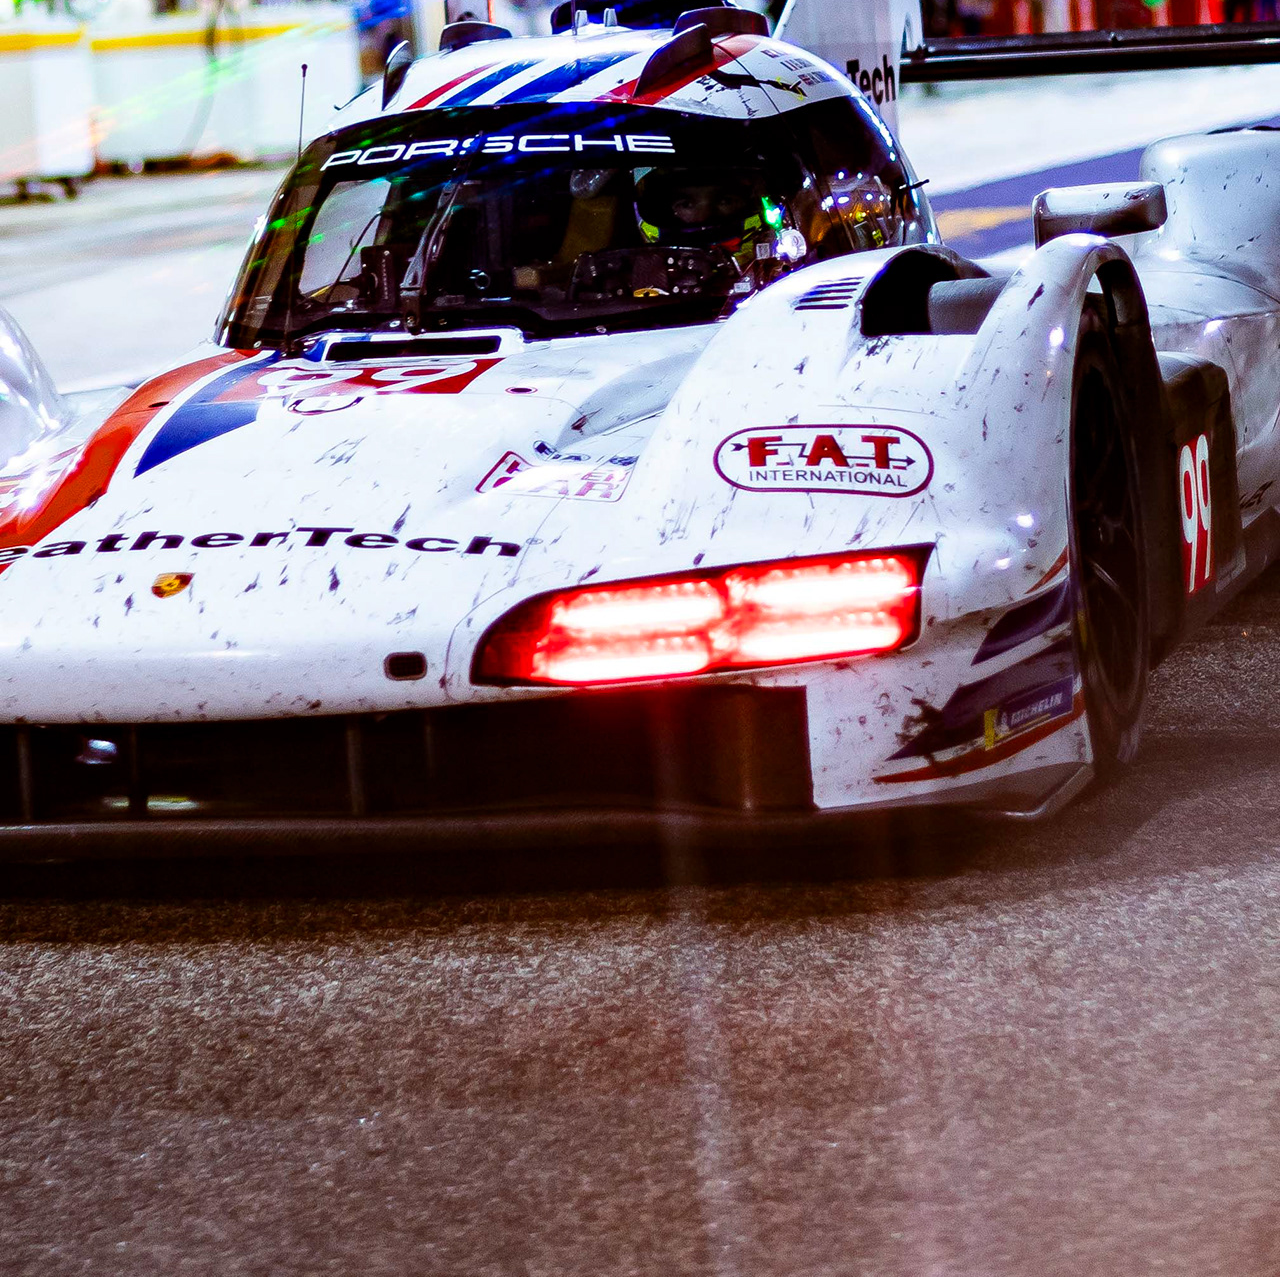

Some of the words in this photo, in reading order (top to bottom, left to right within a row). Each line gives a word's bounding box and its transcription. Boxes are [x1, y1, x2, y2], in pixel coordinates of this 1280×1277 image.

[319, 134, 676, 172] PORSCHE
[256, 362, 478, 398] 99
[747, 434, 907, 471] F.A.T.
[749, 469, 908, 488] INTERNATIONAL
[1179, 434, 1212, 594] 99
[1011, 692, 1063, 726] MICHELIN
